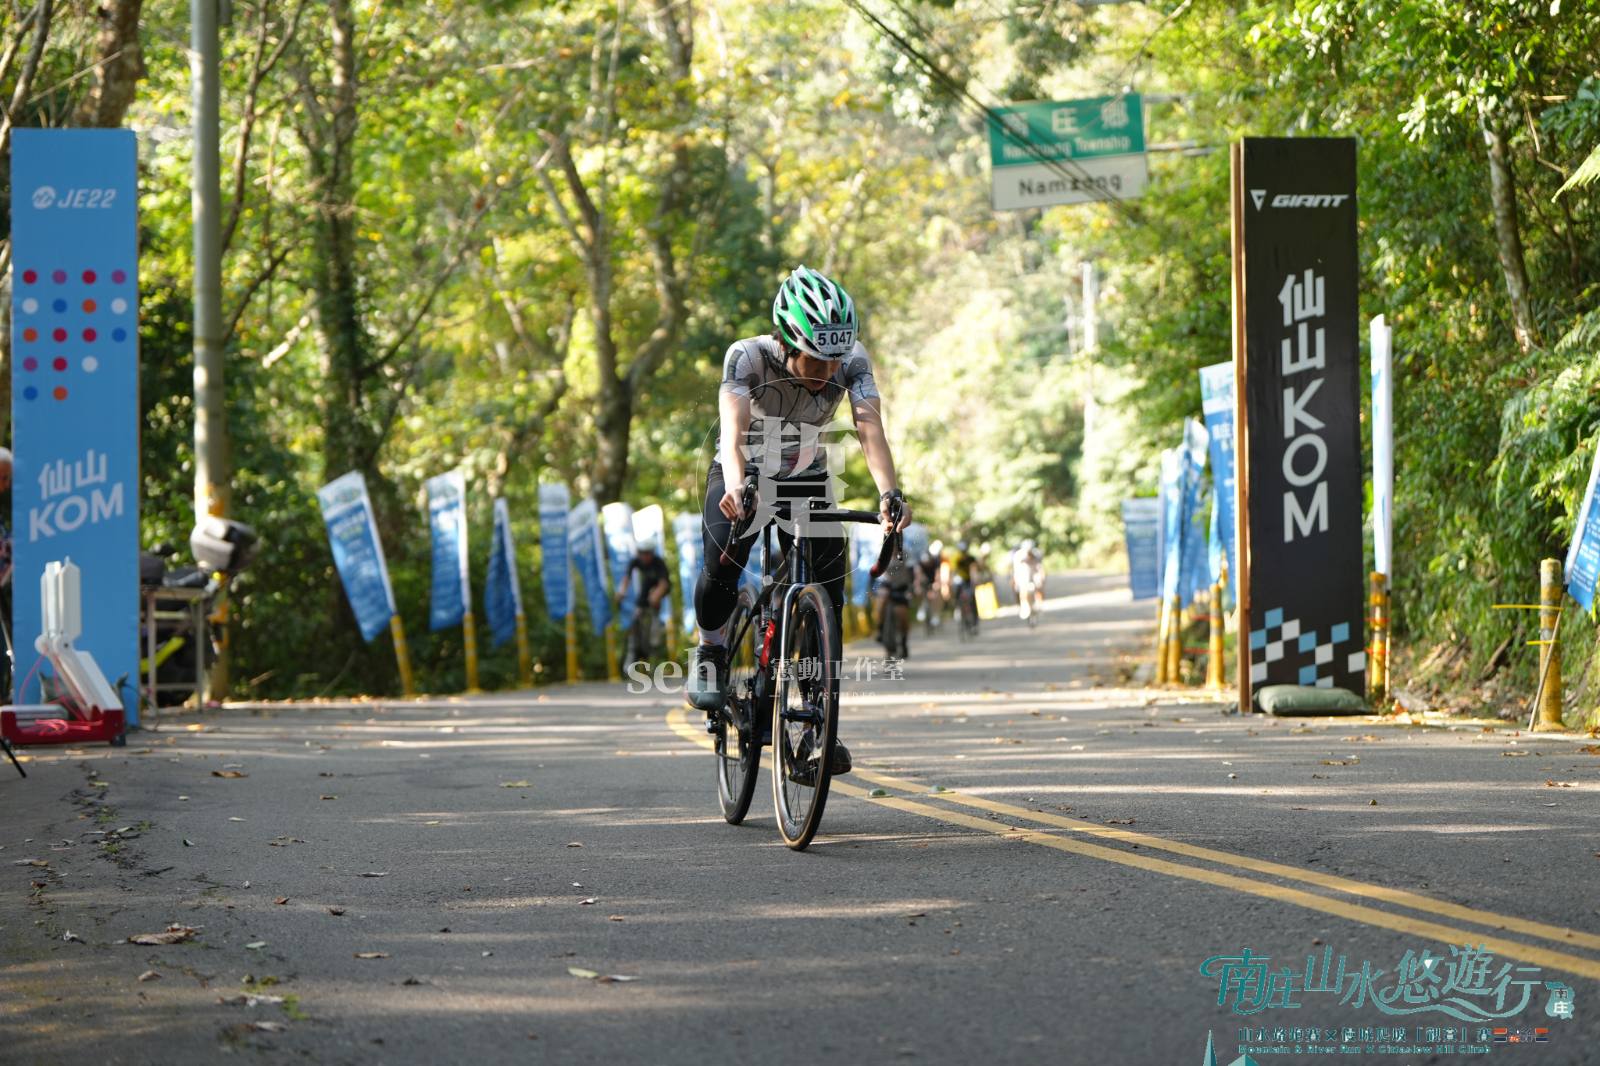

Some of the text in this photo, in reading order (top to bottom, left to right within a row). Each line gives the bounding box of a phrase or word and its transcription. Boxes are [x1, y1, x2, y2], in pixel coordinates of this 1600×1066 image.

[57, 188, 117, 208] JE22
[1271, 194, 1349, 208] GIANT
[38, 449, 107, 500] 仙山
[29, 481, 123, 542] KOM
